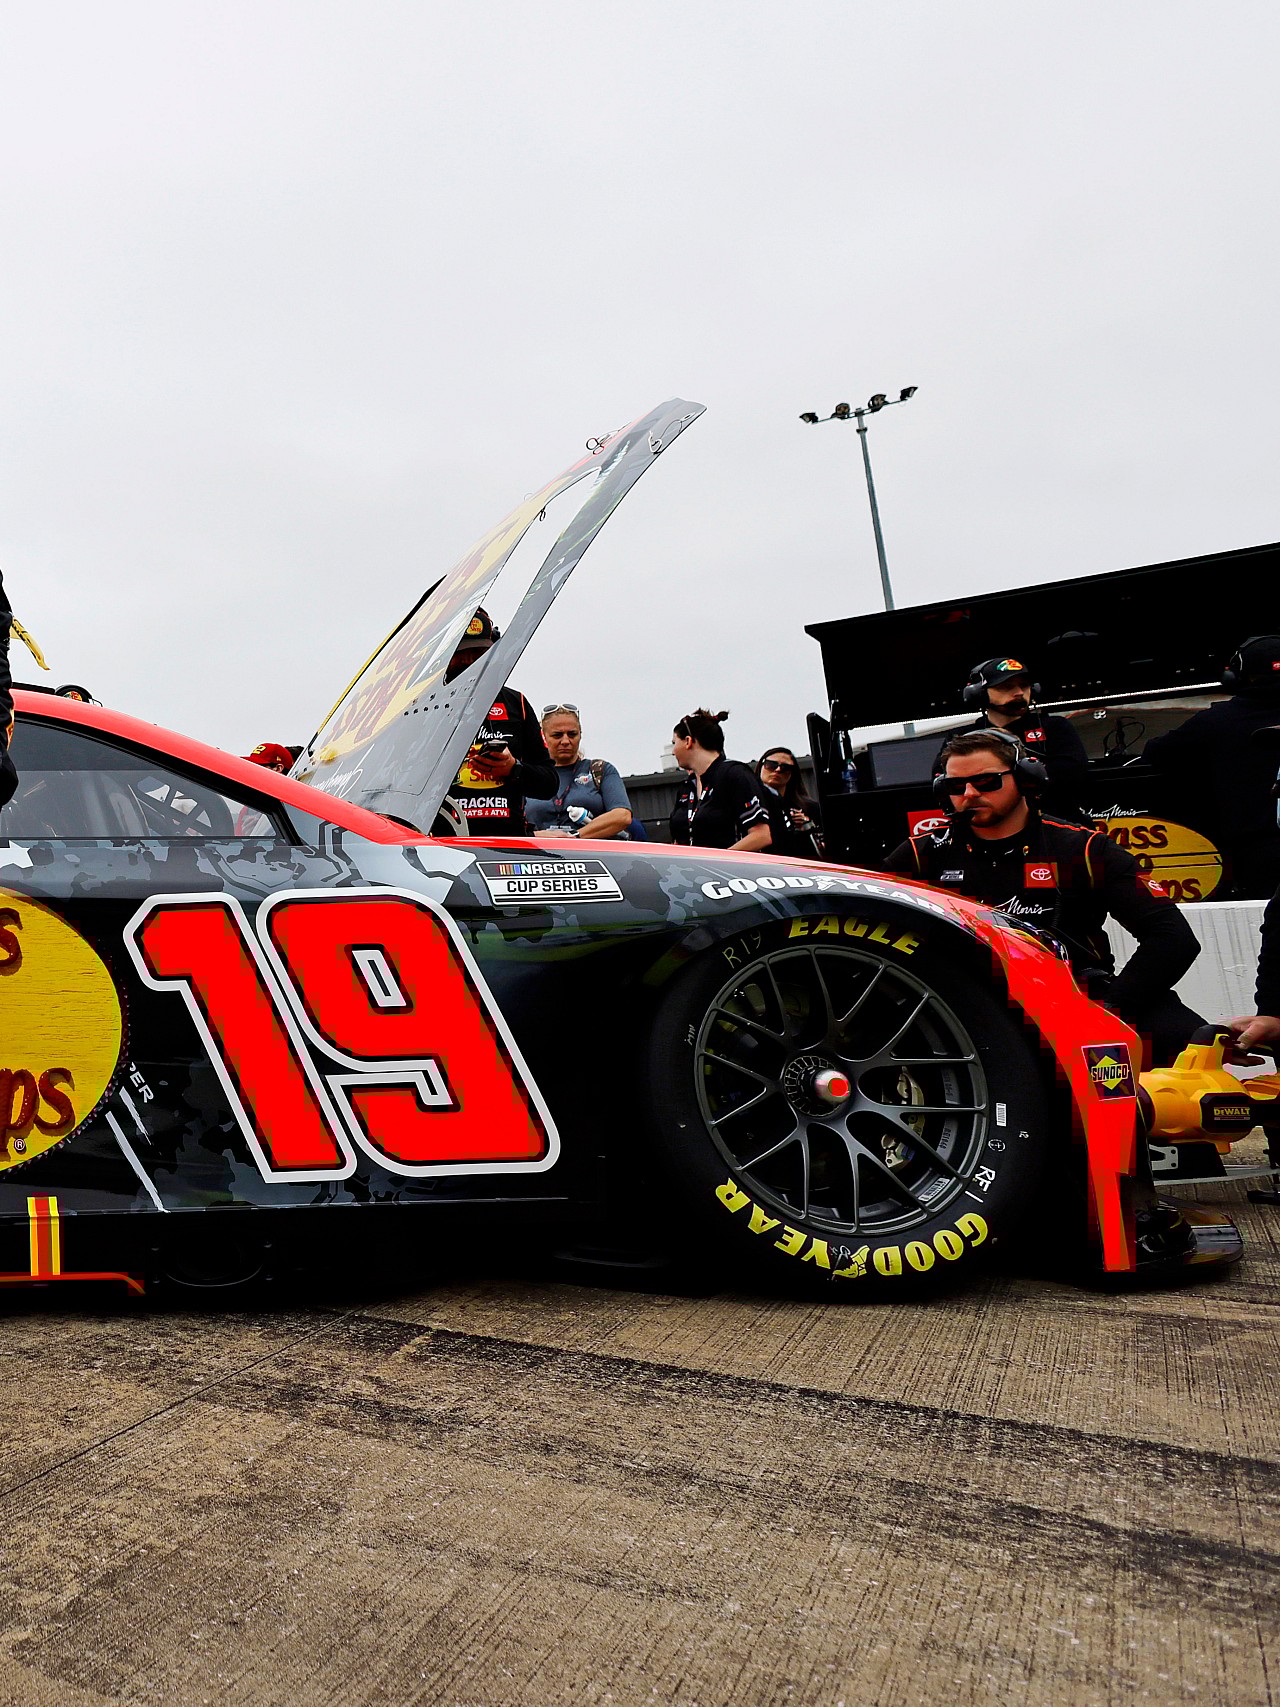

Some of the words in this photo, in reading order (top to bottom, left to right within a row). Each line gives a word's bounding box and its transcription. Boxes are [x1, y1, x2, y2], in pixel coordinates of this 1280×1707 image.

[521, 862, 587, 875] NASCAR
[507, 879, 538, 893] CUP
[542, 878, 598, 893] SERIES
[700, 875, 945, 916] GOODYEAR
[788, 914, 921, 956] EAGLE
[123, 887, 561, 1183] 19
[1091, 1064, 1130, 1082] SUNOCO
